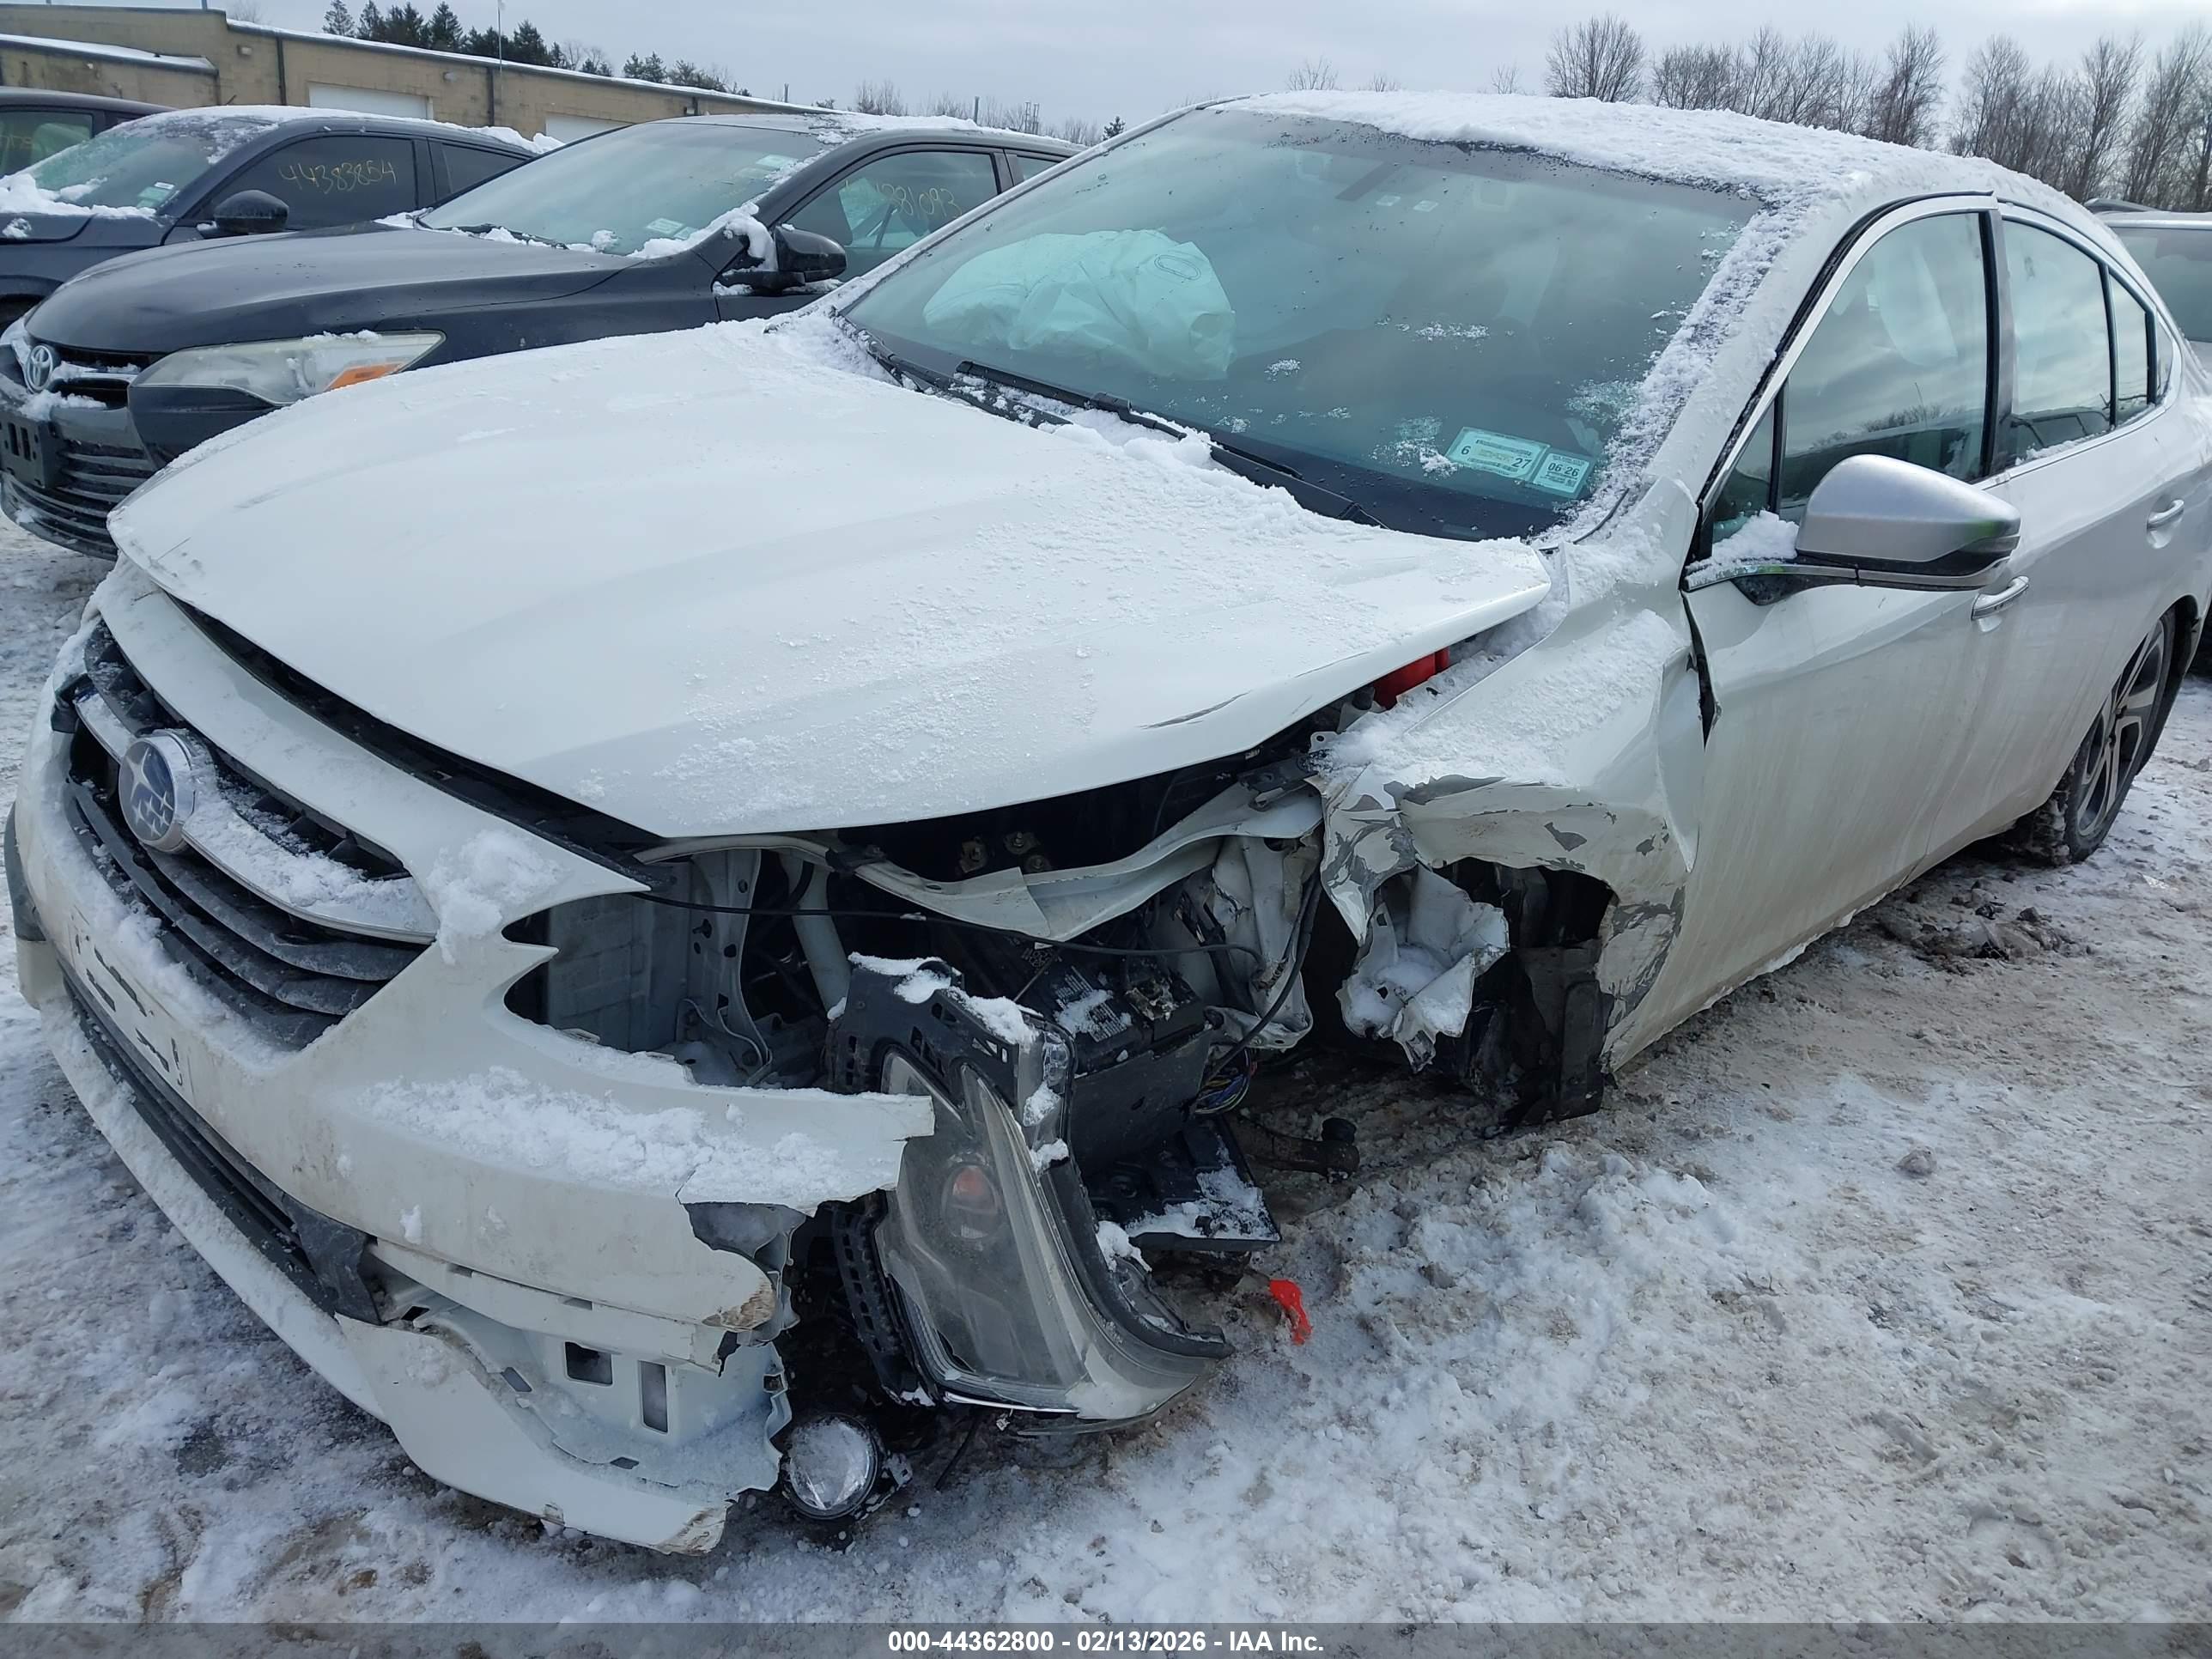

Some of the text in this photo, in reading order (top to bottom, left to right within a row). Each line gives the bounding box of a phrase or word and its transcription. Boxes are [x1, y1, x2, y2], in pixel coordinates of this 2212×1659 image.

[1461, 445, 1472, 455] 6
[1511, 457, 1533, 469] 27
[1547, 462, 1580, 477] 06 26
